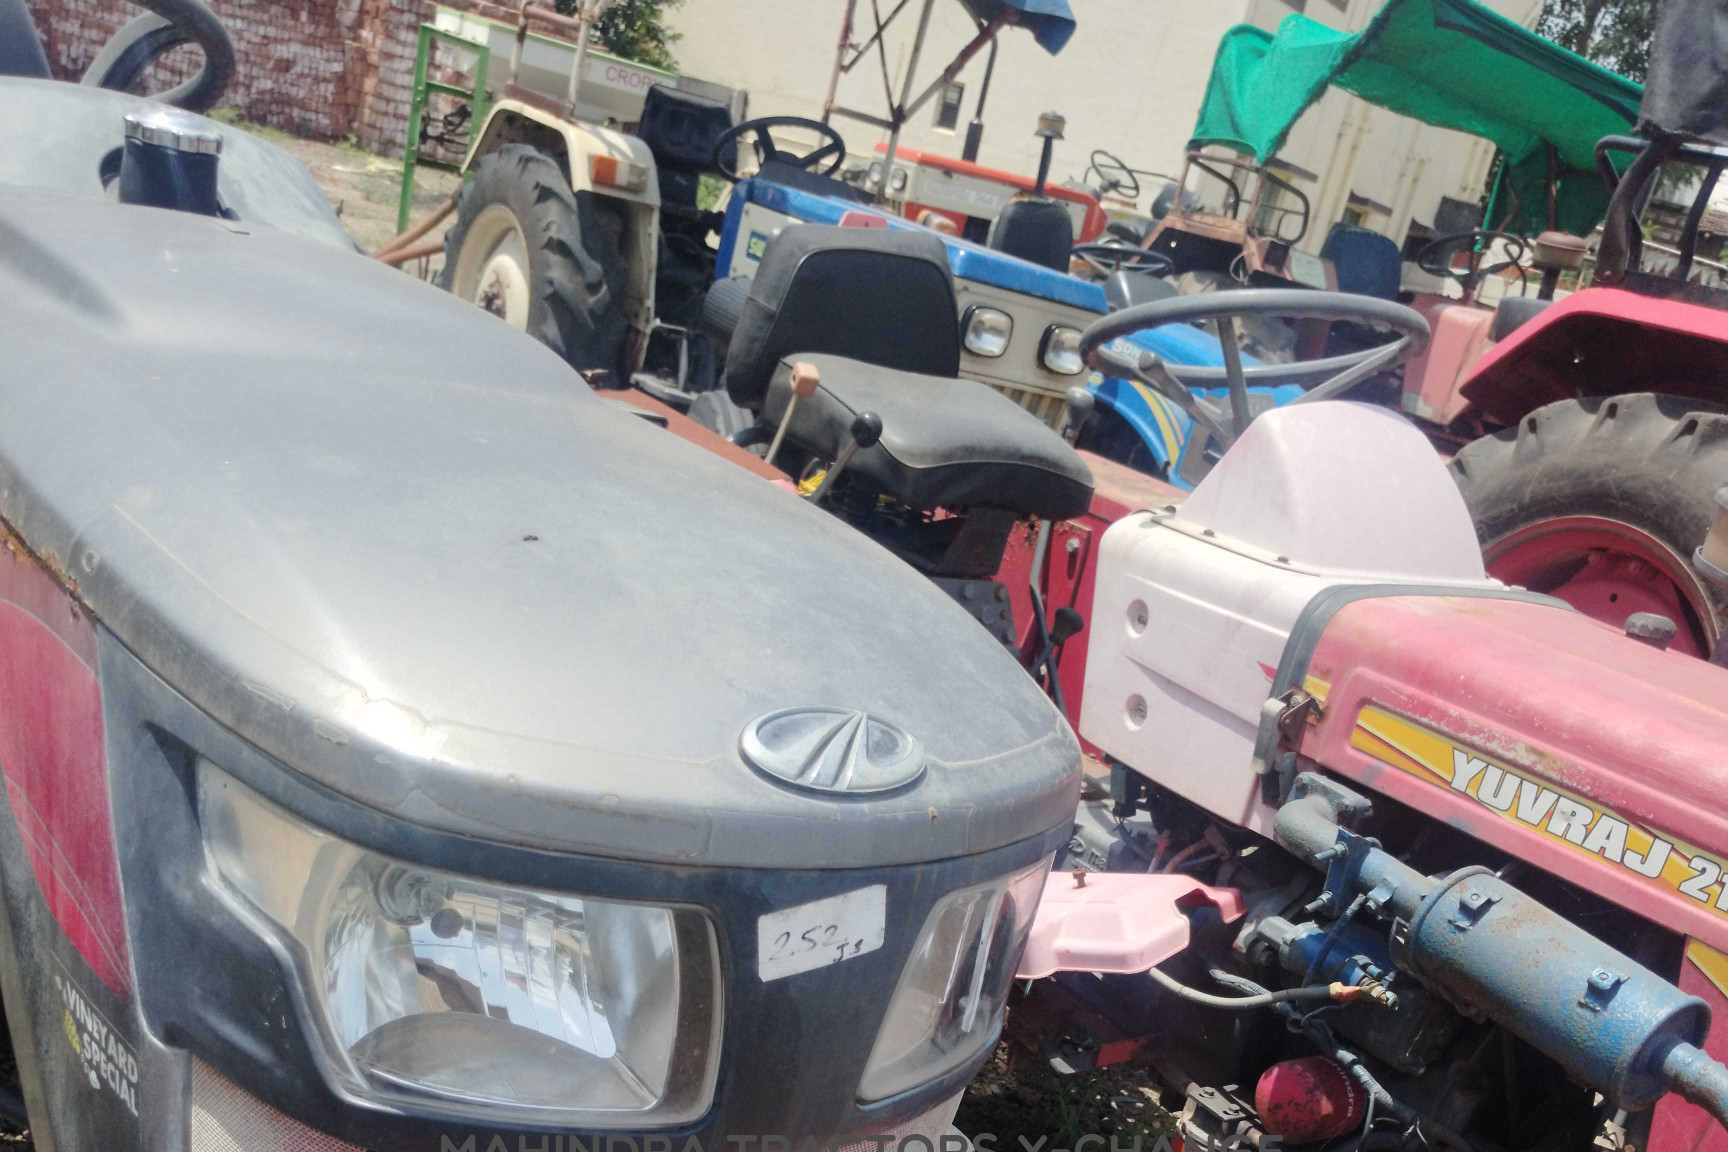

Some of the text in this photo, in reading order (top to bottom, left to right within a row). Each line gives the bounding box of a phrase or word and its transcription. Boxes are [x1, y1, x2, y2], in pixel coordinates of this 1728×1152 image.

[1450, 746, 1674, 879] YUVRAJ
[66, 980, 139, 1084] VINEYARD
[83, 1032, 139, 1118] SPECIAL
